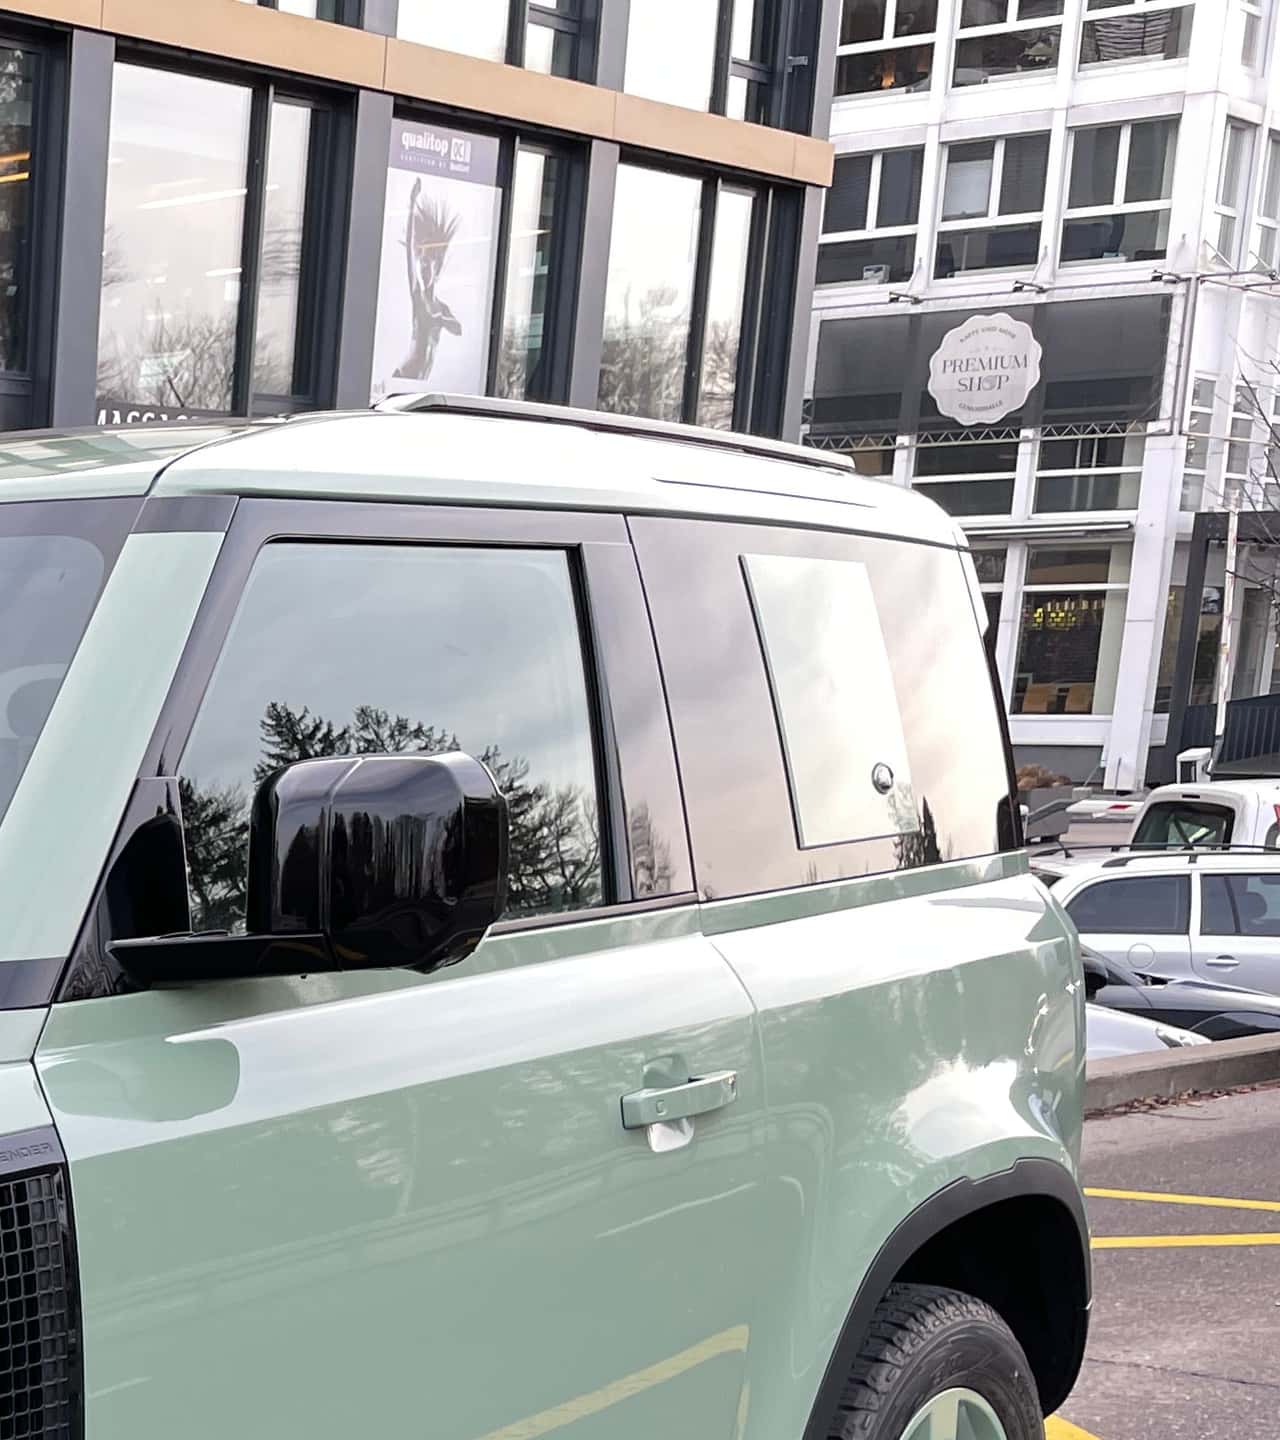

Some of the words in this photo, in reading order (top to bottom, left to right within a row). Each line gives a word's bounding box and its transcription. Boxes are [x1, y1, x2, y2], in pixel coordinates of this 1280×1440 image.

[401, 131, 449, 157] qualitop
[941, 354, 1028, 374] PREMIUM
[957, 374, 1010, 392] SHOP
